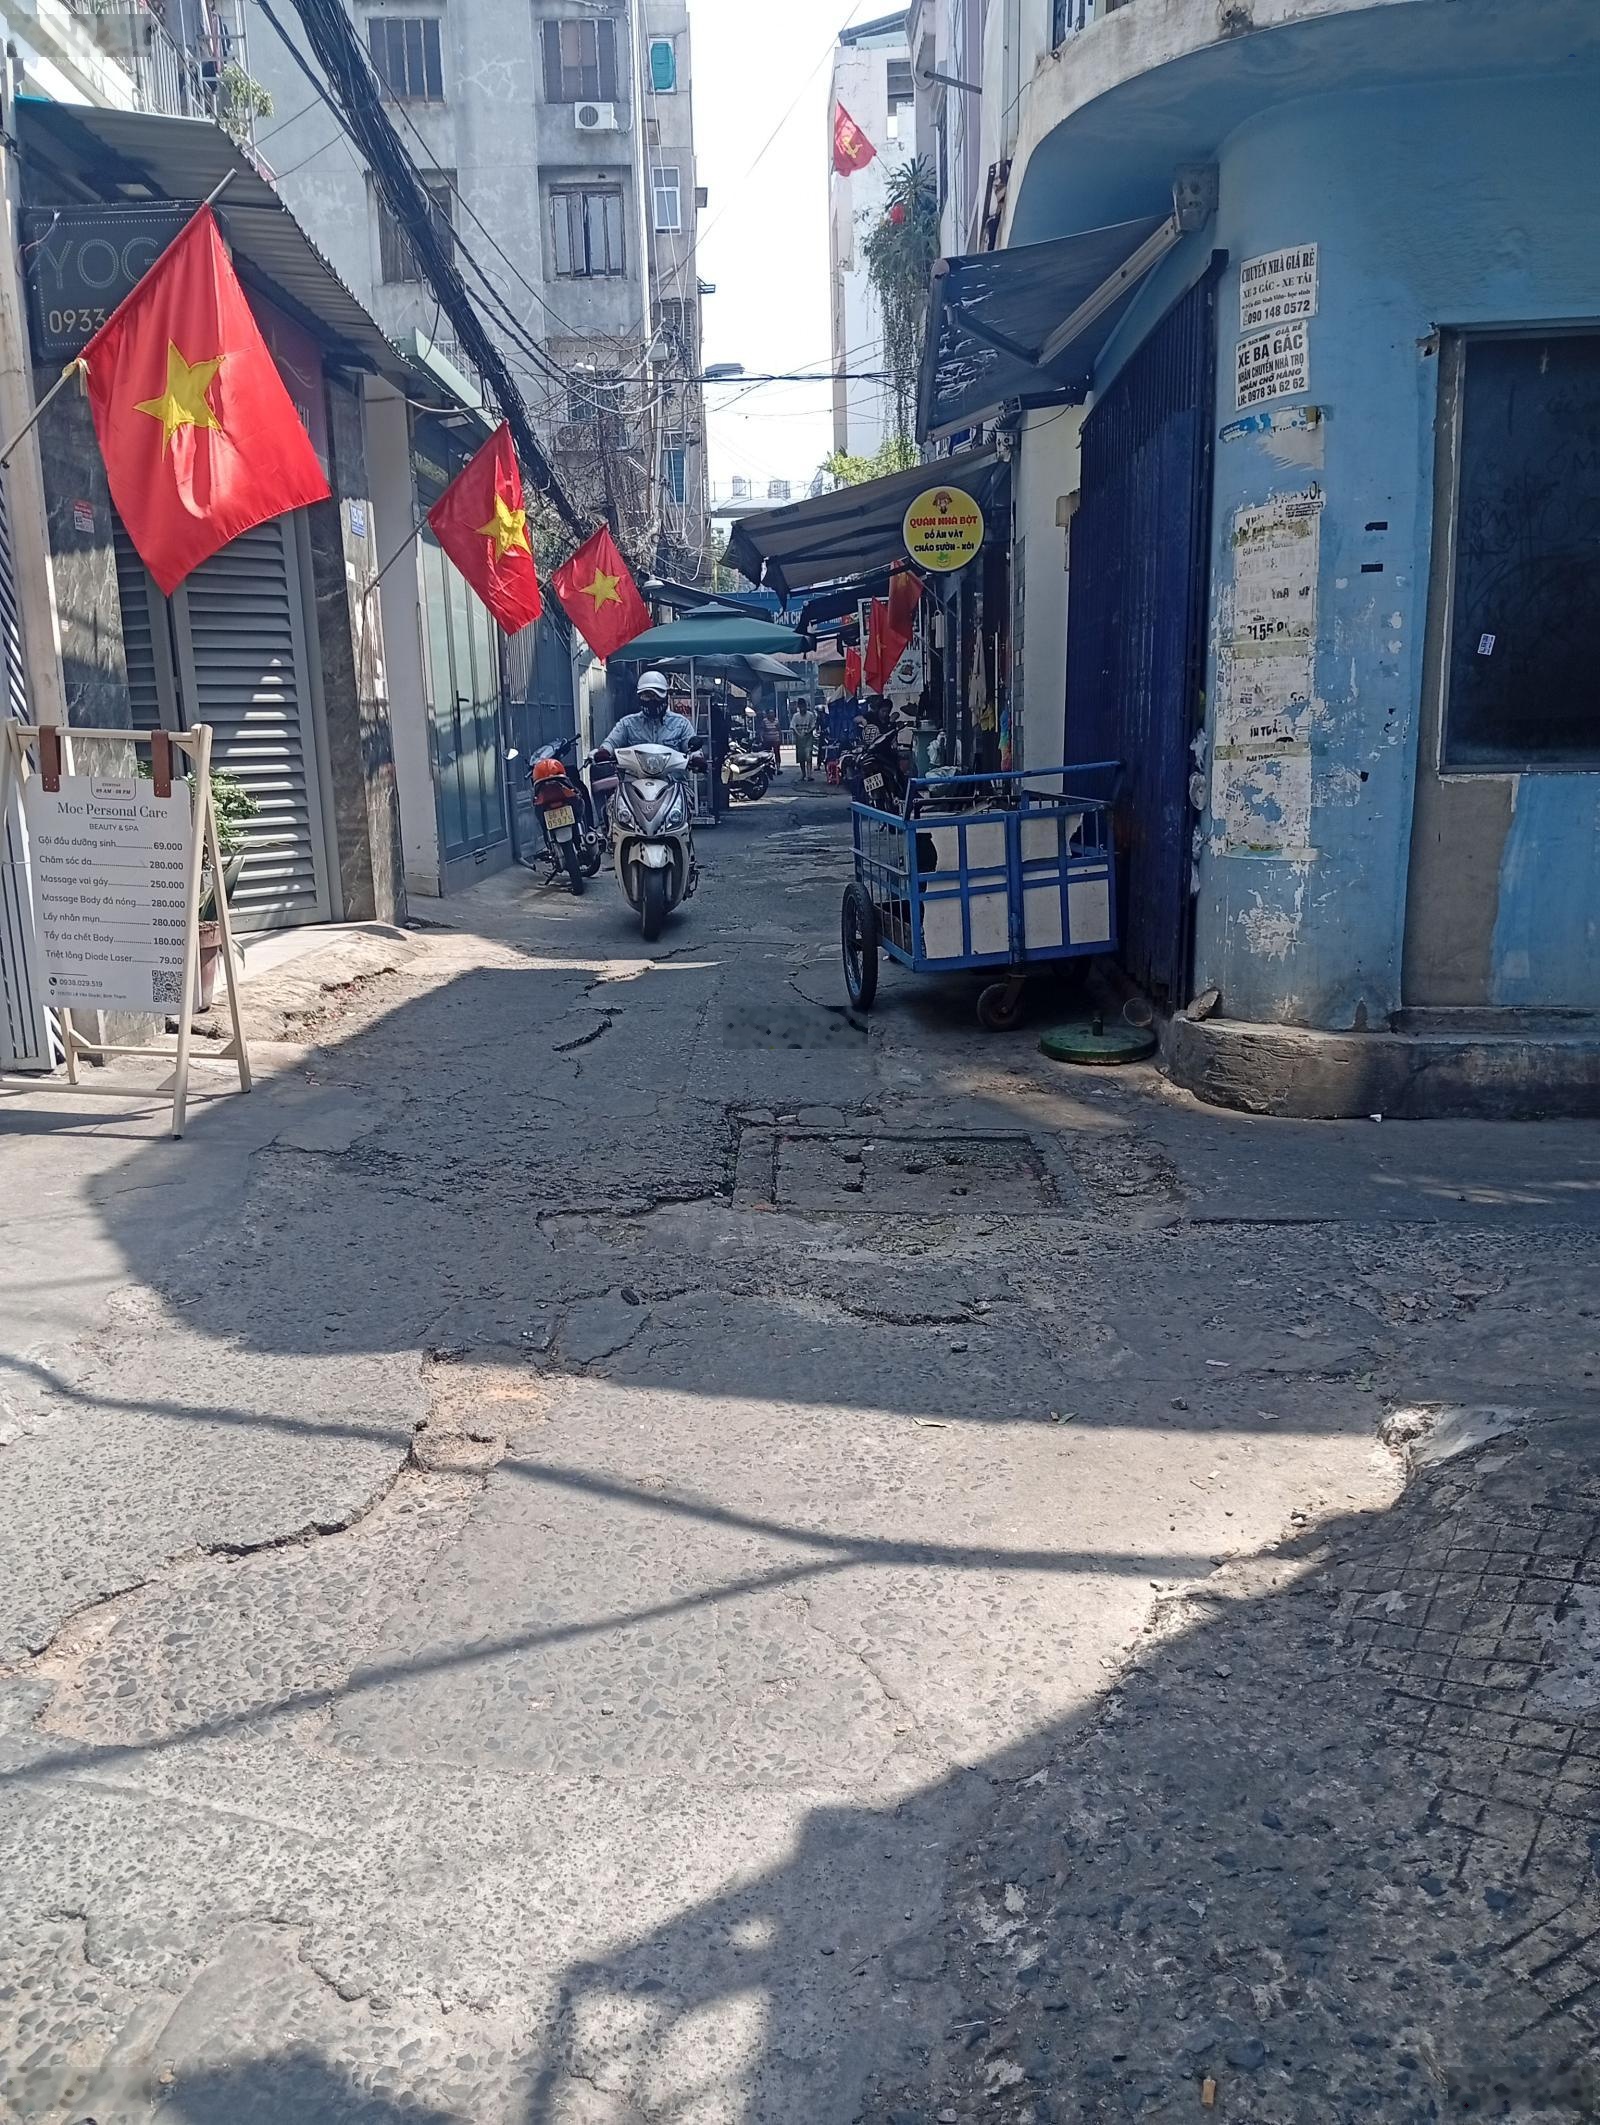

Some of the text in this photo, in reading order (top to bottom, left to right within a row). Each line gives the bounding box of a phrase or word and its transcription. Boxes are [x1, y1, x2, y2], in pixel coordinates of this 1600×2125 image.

[1242, 248, 1314, 283] CHUYỂN NHÀ GIÁ RẺ
[1243, 287, 1252, 298] XE
[1253, 286, 1257, 296] 3
[1259, 280, 1274, 293] GÁC
[1282, 277, 1294, 288] XE
[1297, 272, 1312, 284] TẢI
[1248, 310, 1262, 324] 090
[1265, 305, 1280, 319] 148
[1284, 300, 1310, 314] 0572
[1275, 326, 1290, 336] GIÁ
[1238, 334, 1303, 369] XE BA GÁC
[1252, 358, 1273, 378] CHUYỂN
[1275, 354, 1288, 370] NHÀ
[1290, 353, 1304, 366] TRỌ
[1248, 387, 1265, 402] 0978
[1267, 384, 1276, 396] 34
[1279, 380, 1290, 392] 62
[1293, 377, 1304, 389] 62
[914, 543, 934, 552] CHÁO
[86, 804, 137, 817] Personal
[139, 806, 168, 818] Care
[153, 842, 183, 851] 69.000
[66, 856, 80, 865] sóc
[81, 857, 92, 865] da
[150, 861, 184, 870] 280.000
[40, 875, 77, 886] Massage
[94, 878, 109, 887] gáy
[150, 880, 184, 889] 250.000
[42, 894, 78, 904] Massage
[80, 896, 100, 906] Body
[116, 898, 136, 908] nóng
[151, 900, 185, 909] 280.000
[152, 918, 186, 928] 280.000
[93, 934, 114, 944] Body
[84, 952, 108, 961] Diode
[110, 954, 133, 962] Laser
[160, 956, 184, 965] 79.00
